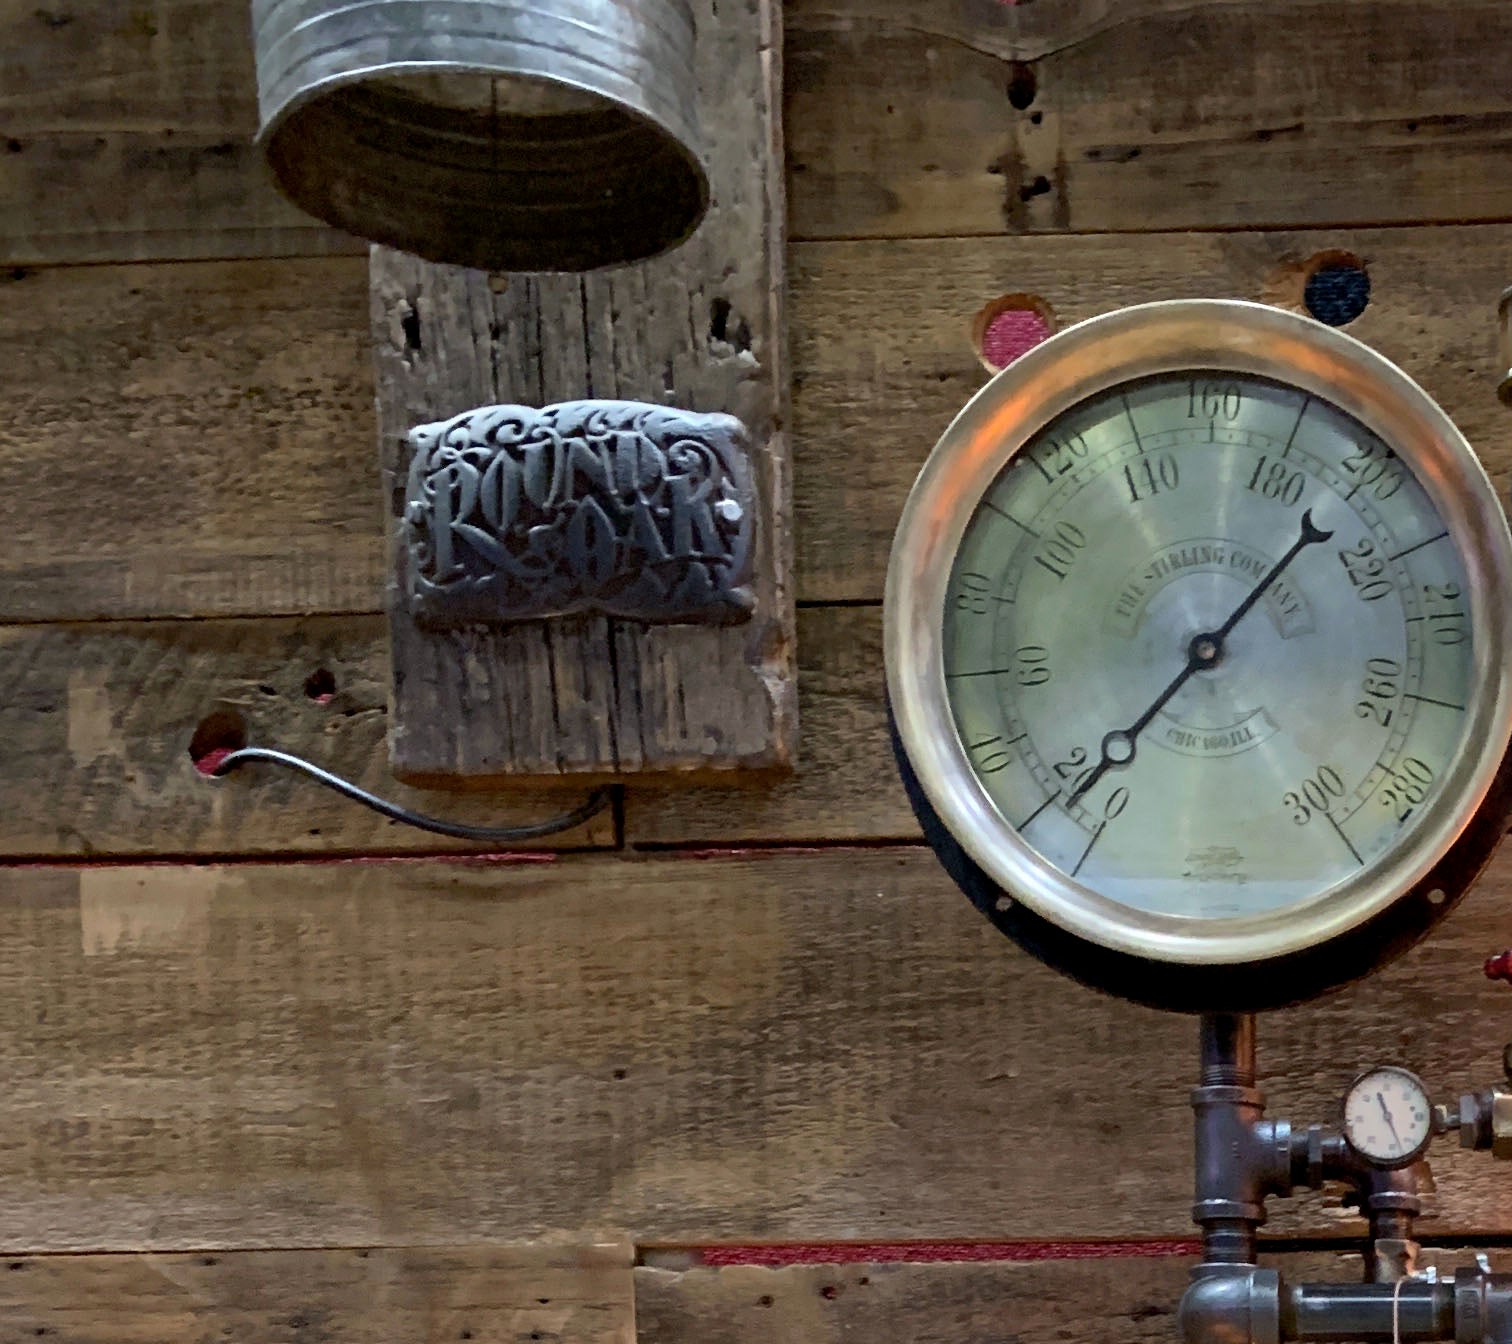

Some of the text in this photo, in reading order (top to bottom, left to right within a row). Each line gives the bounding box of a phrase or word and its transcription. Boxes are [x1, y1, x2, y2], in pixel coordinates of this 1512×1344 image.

[1186, 381, 1241, 421] 160
[1027, 431, 1089, 484] 120
[1245, 456, 1306, 507] 180
[1341, 443, 1404, 502] 200
[1036, 521, 1087, 583] 100
[1338, 538, 1394, 602] 220
[955, 571, 992, 616] 80
[1229, 551, 1303, 618] COMANY
[1015, 645, 1052, 687] 60
[1357, 657, 1401, 728] 260
[1105, 785, 1130, 821] 0
[1283, 765, 1346, 826] 300
[1379, 756, 1434, 823] 280
